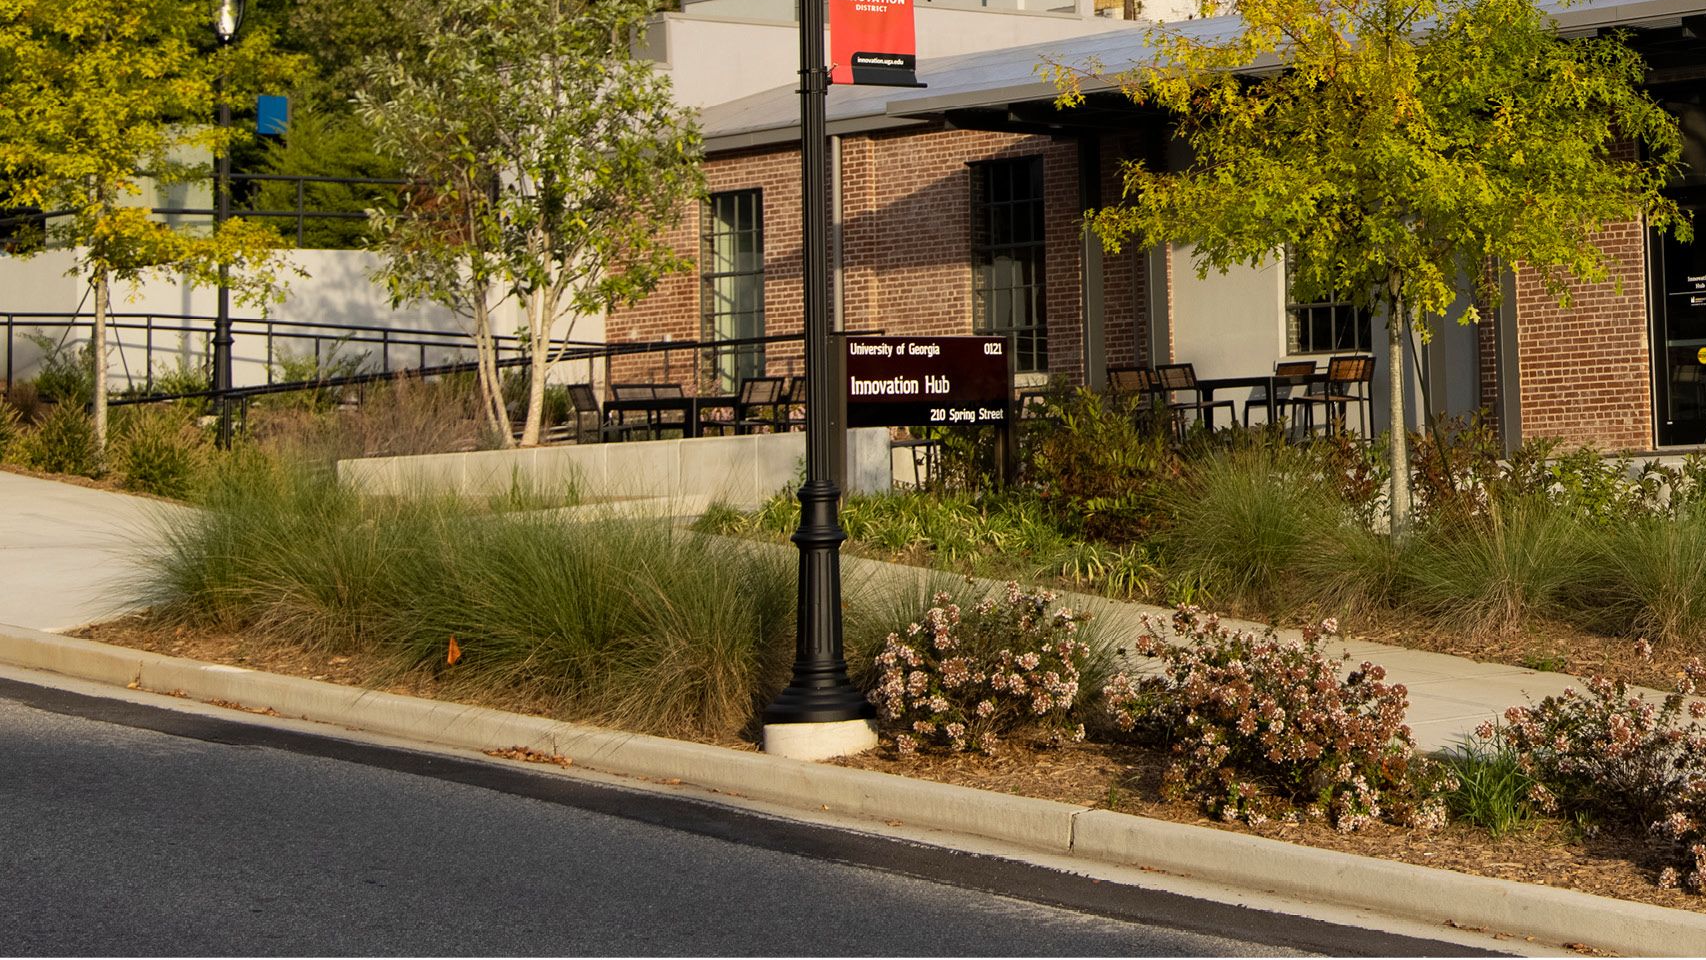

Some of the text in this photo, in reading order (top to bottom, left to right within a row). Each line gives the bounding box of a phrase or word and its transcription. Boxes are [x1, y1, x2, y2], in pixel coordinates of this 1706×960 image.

[855, 4, 888, 13] DISTRICT
[856, 56, 904, 66] innovation.uga.edu
[850, 342, 940, 358] University of Georgia
[983, 343, 1003, 355] 0121
[851, 375, 950, 395] Innovation Hub
[930, 408, 1004, 423] 210 Spring Street
